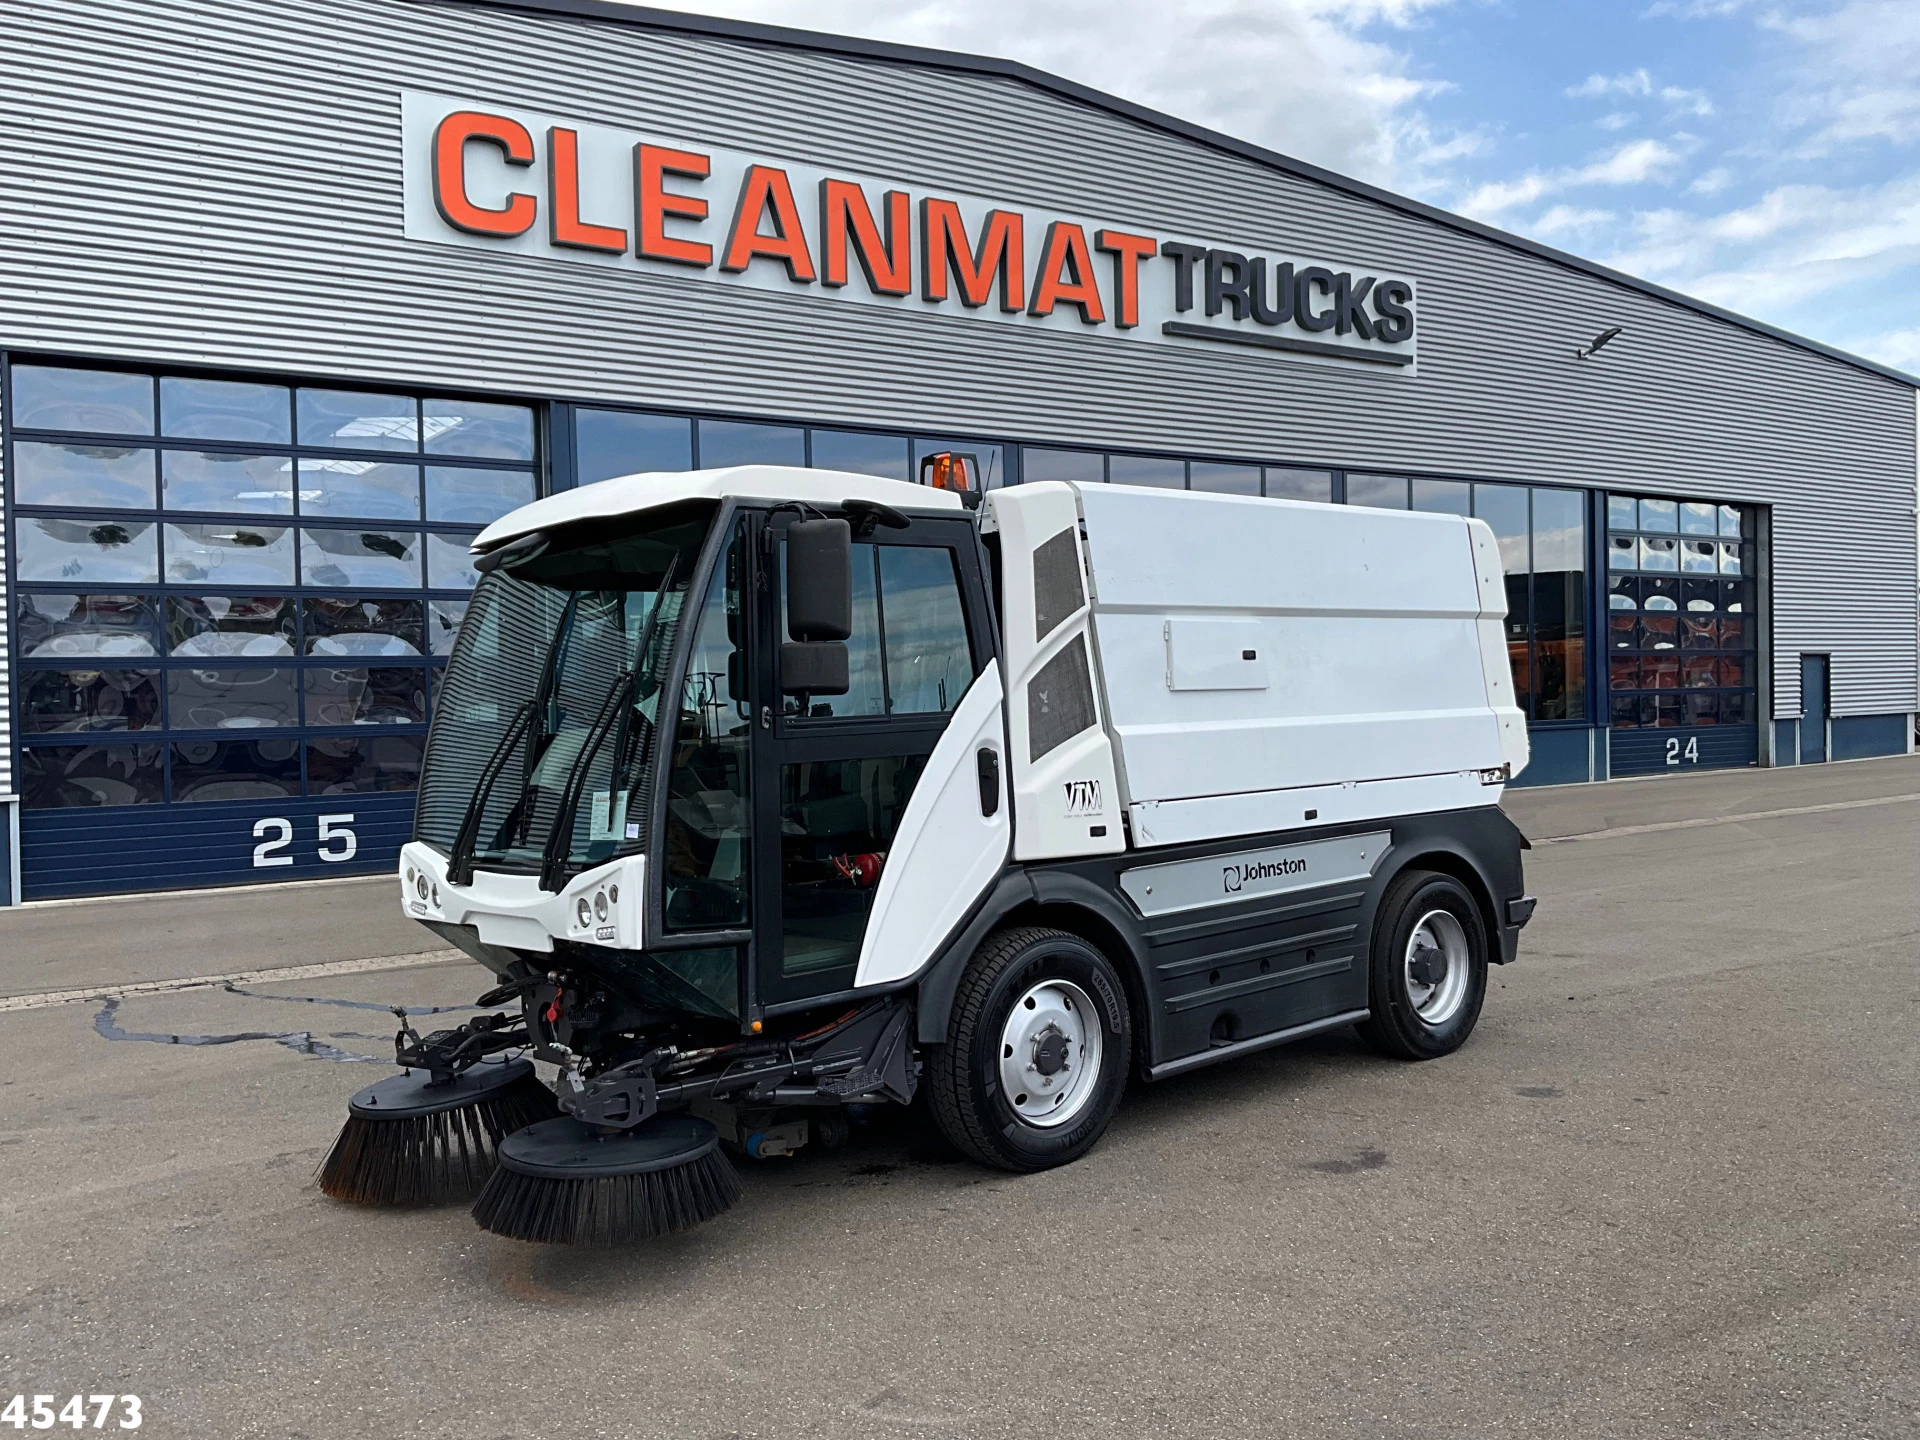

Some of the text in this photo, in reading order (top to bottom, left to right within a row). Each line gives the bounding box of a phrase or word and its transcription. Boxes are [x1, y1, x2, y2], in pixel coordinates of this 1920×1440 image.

[433, 110, 1414, 343] CLEANMAT TRUCKS
[1666, 736, 1699, 765] 24
[1243, 859, 1306, 882] Johnston
